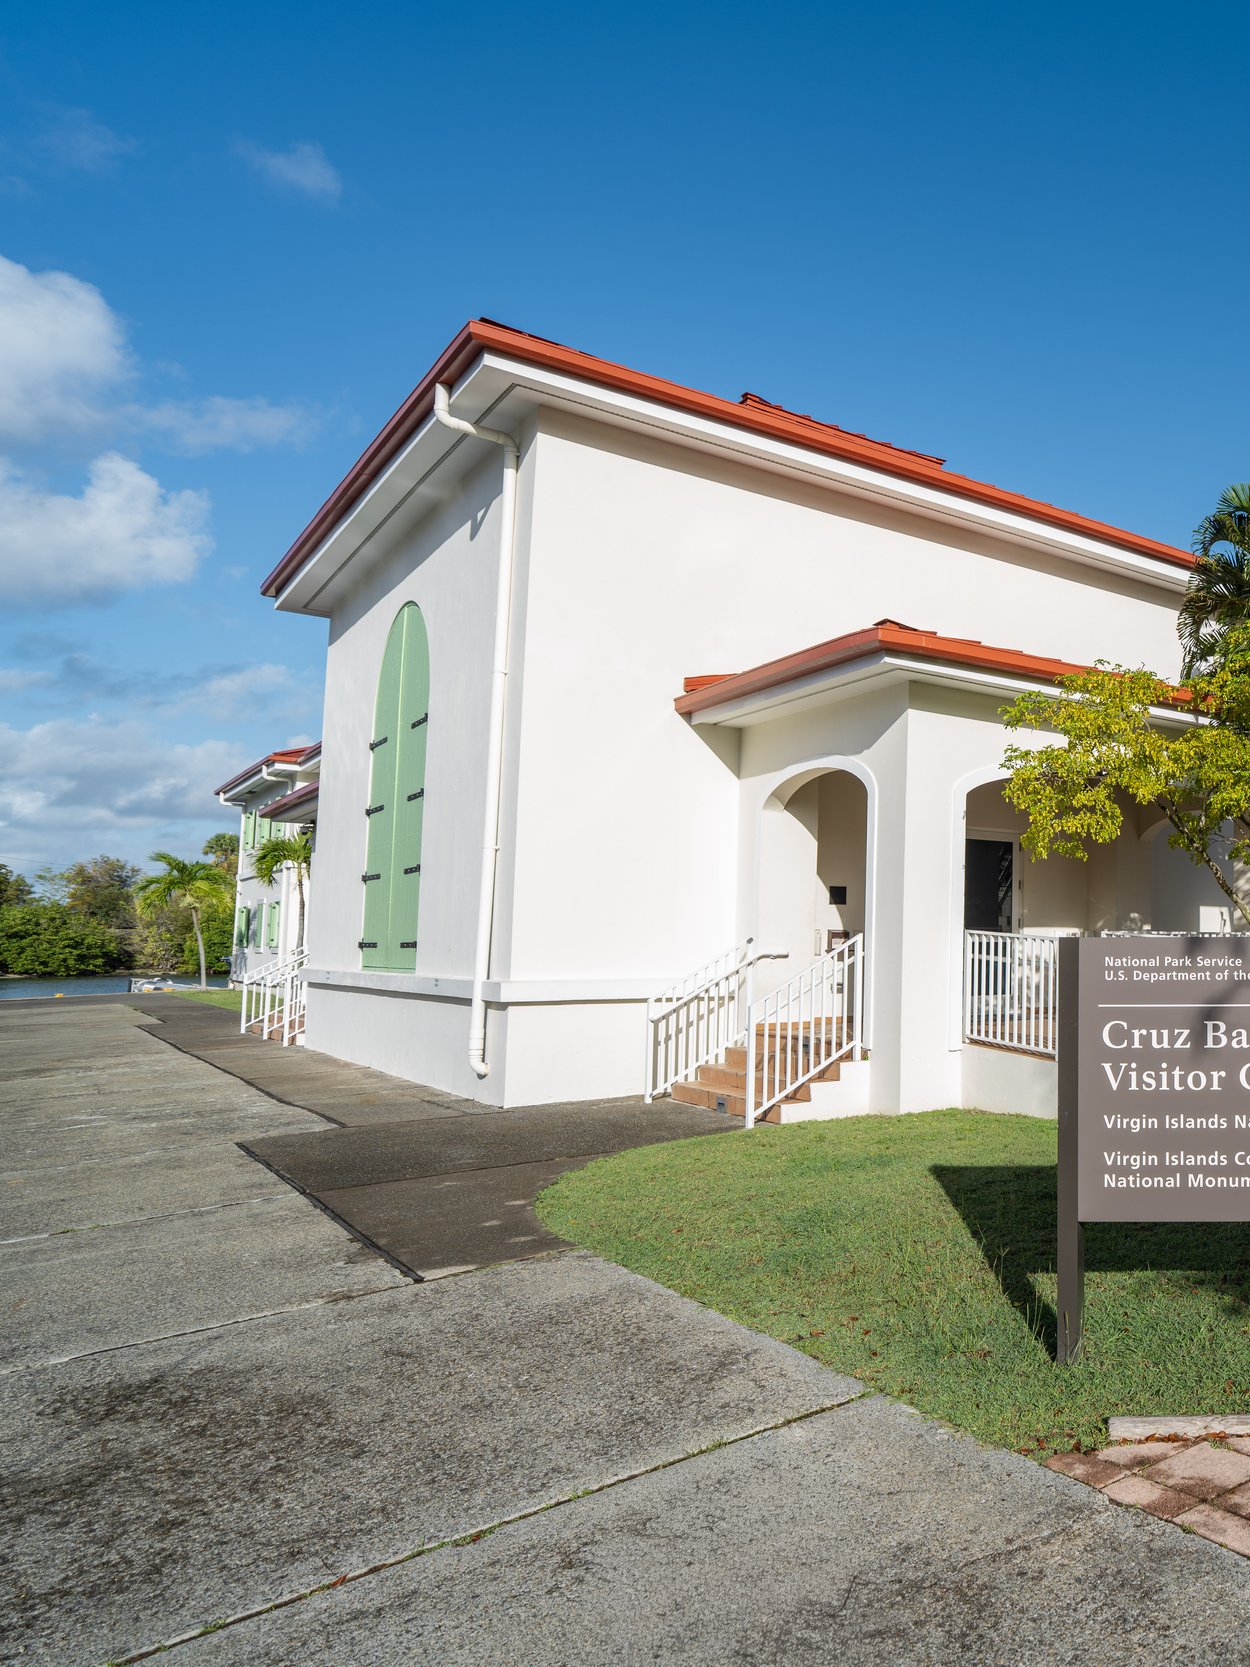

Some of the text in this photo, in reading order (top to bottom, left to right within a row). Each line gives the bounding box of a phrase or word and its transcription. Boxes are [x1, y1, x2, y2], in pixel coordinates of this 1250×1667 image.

[1104, 955, 1243, 967] National Park Service
[1104, 970, 1129, 981] U.S.
[1133, 970, 1211, 984] Department
[1214, 969, 1230, 981] of
[1102, 1020, 1191, 1049] Cruz
[1101, 1062, 1227, 1091] Visitor
[1103, 1114, 1158, 1133] Virgin
[1165, 1114, 1228, 1129] Islands
[1103, 1151, 1158, 1170] Virgin
[1165, 1151, 1228, 1166] Islands
[1103, 1173, 1181, 1188] National
